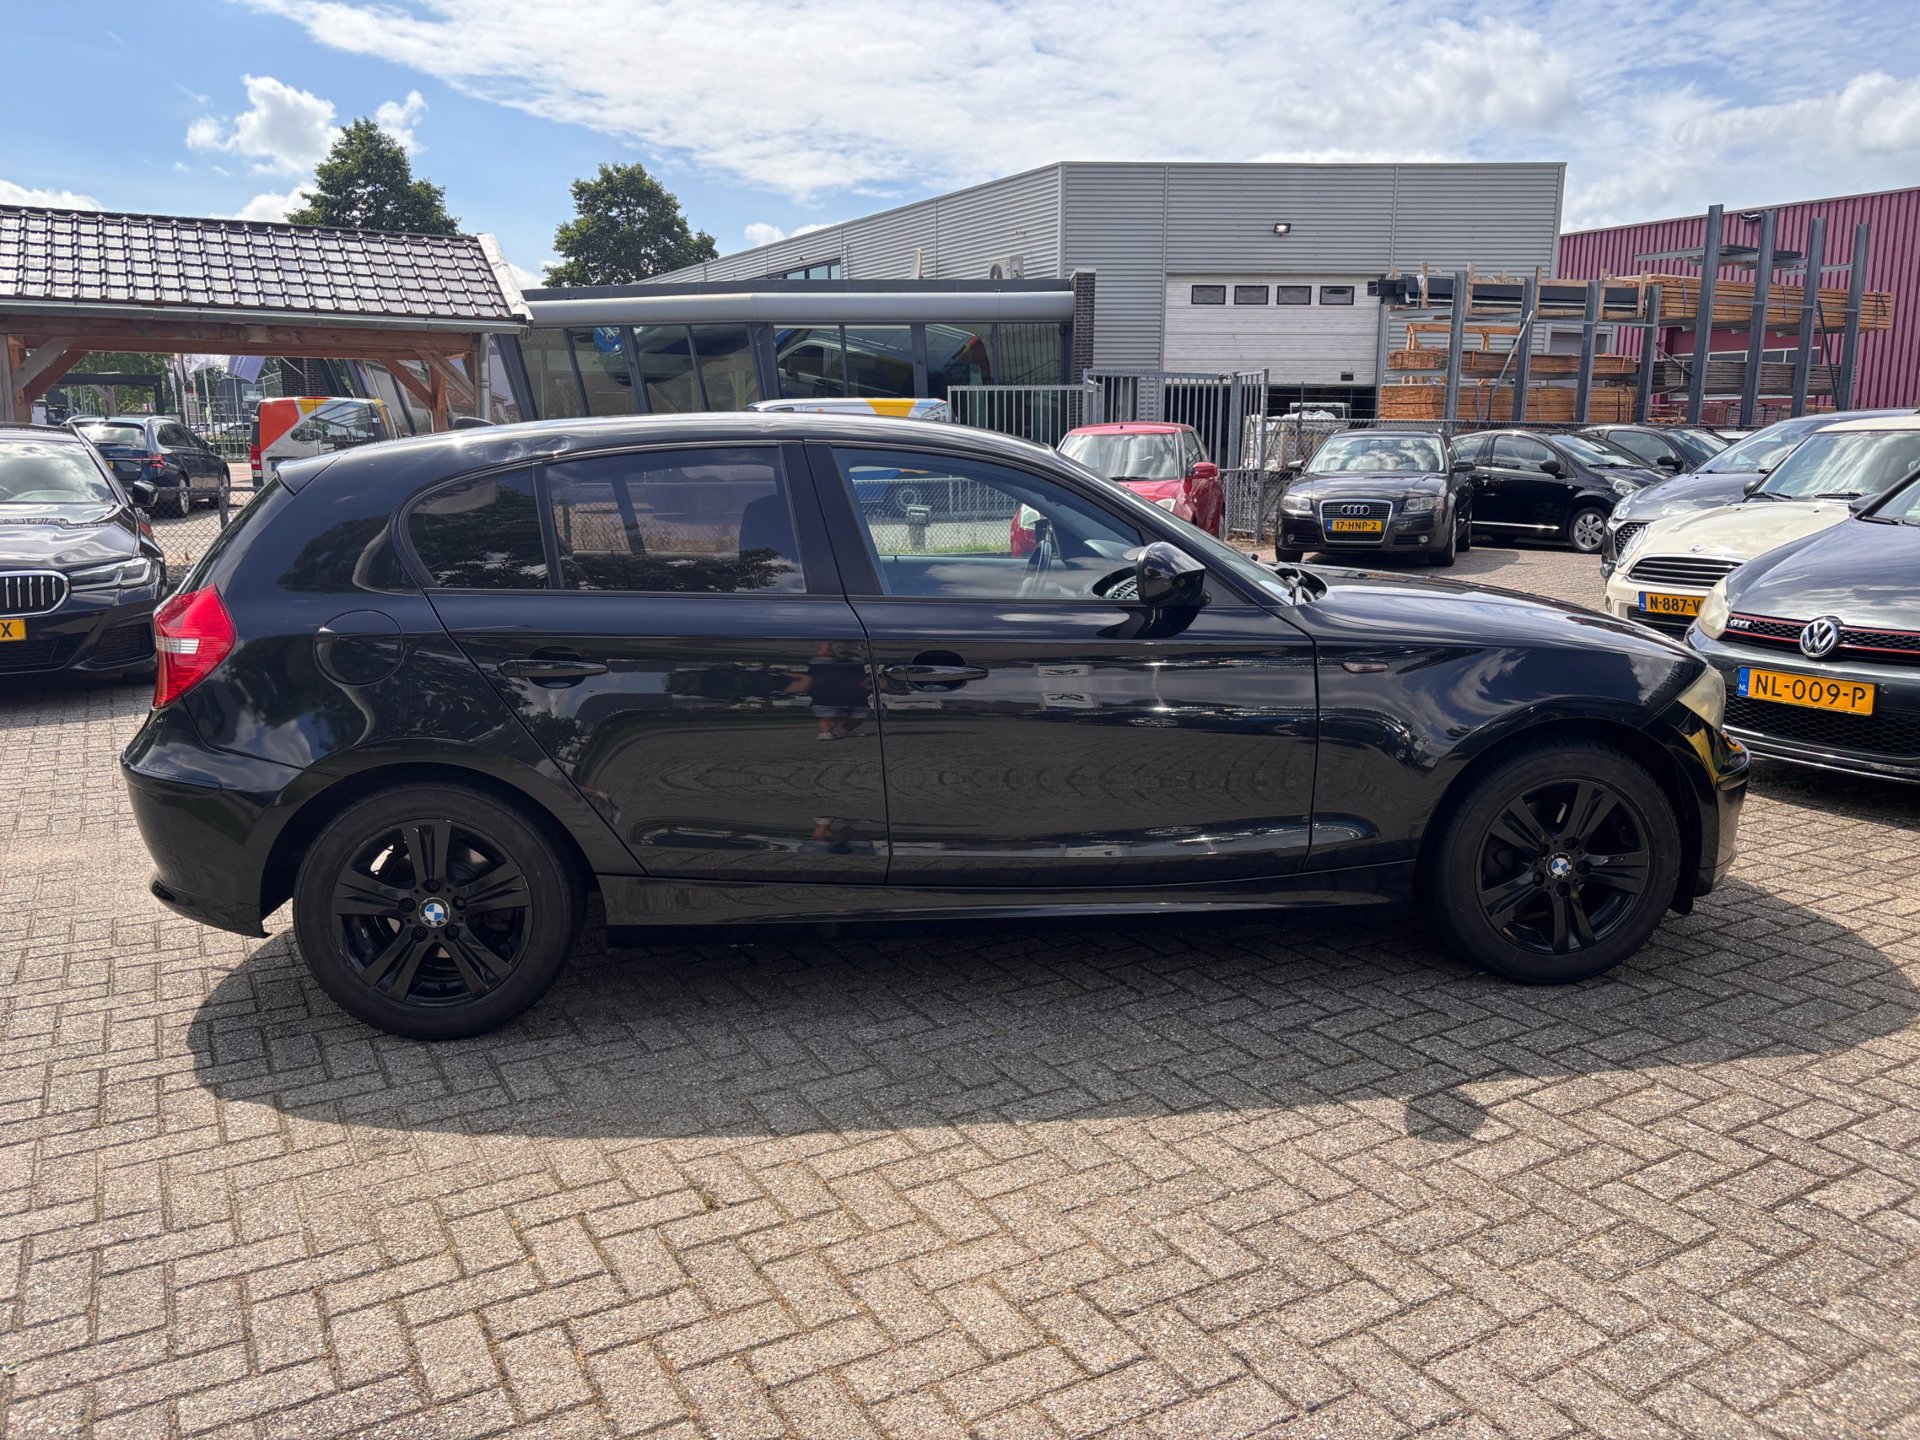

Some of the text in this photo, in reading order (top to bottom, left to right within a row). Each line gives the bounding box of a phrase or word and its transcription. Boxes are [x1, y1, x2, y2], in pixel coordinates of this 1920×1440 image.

[1335, 521, 1377, 531] 17-HNP-2
[1649, 596, 1704, 614] N-887-V
[1730, 619, 1751, 629] GTI
[1738, 683, 1748, 692] NL
[1755, 673, 1867, 708] NL-009-P
